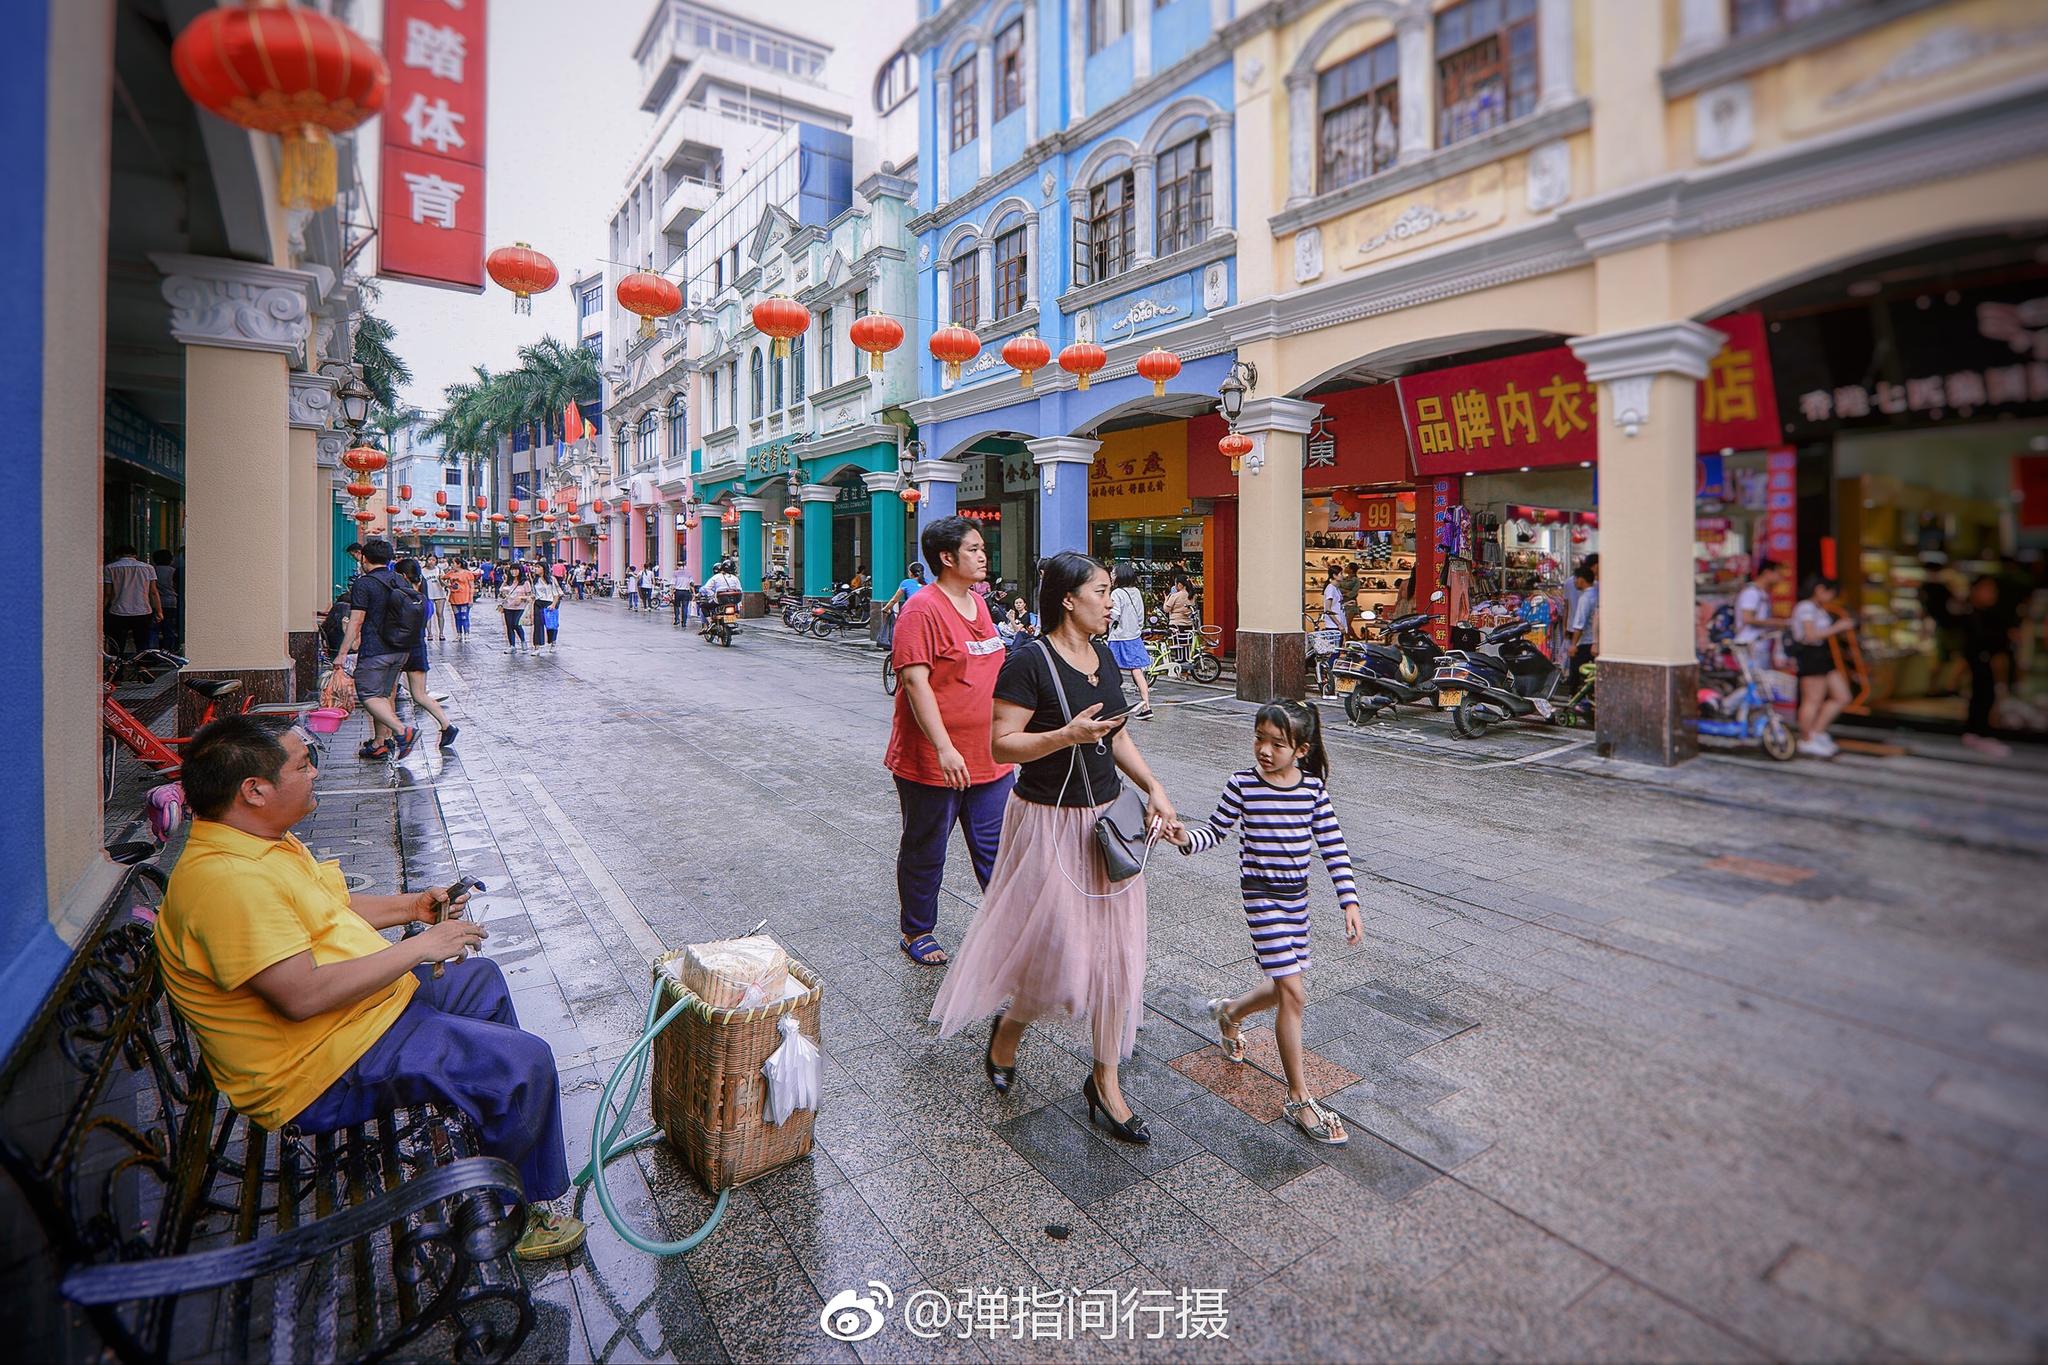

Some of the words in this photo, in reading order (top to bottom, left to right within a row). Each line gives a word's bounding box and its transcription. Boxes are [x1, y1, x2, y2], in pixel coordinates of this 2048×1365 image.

[402, 0, 466, 229] 踏体育
[835, 484, 868, 501] 区社区
[1368, 502, 1391, 528] 99
